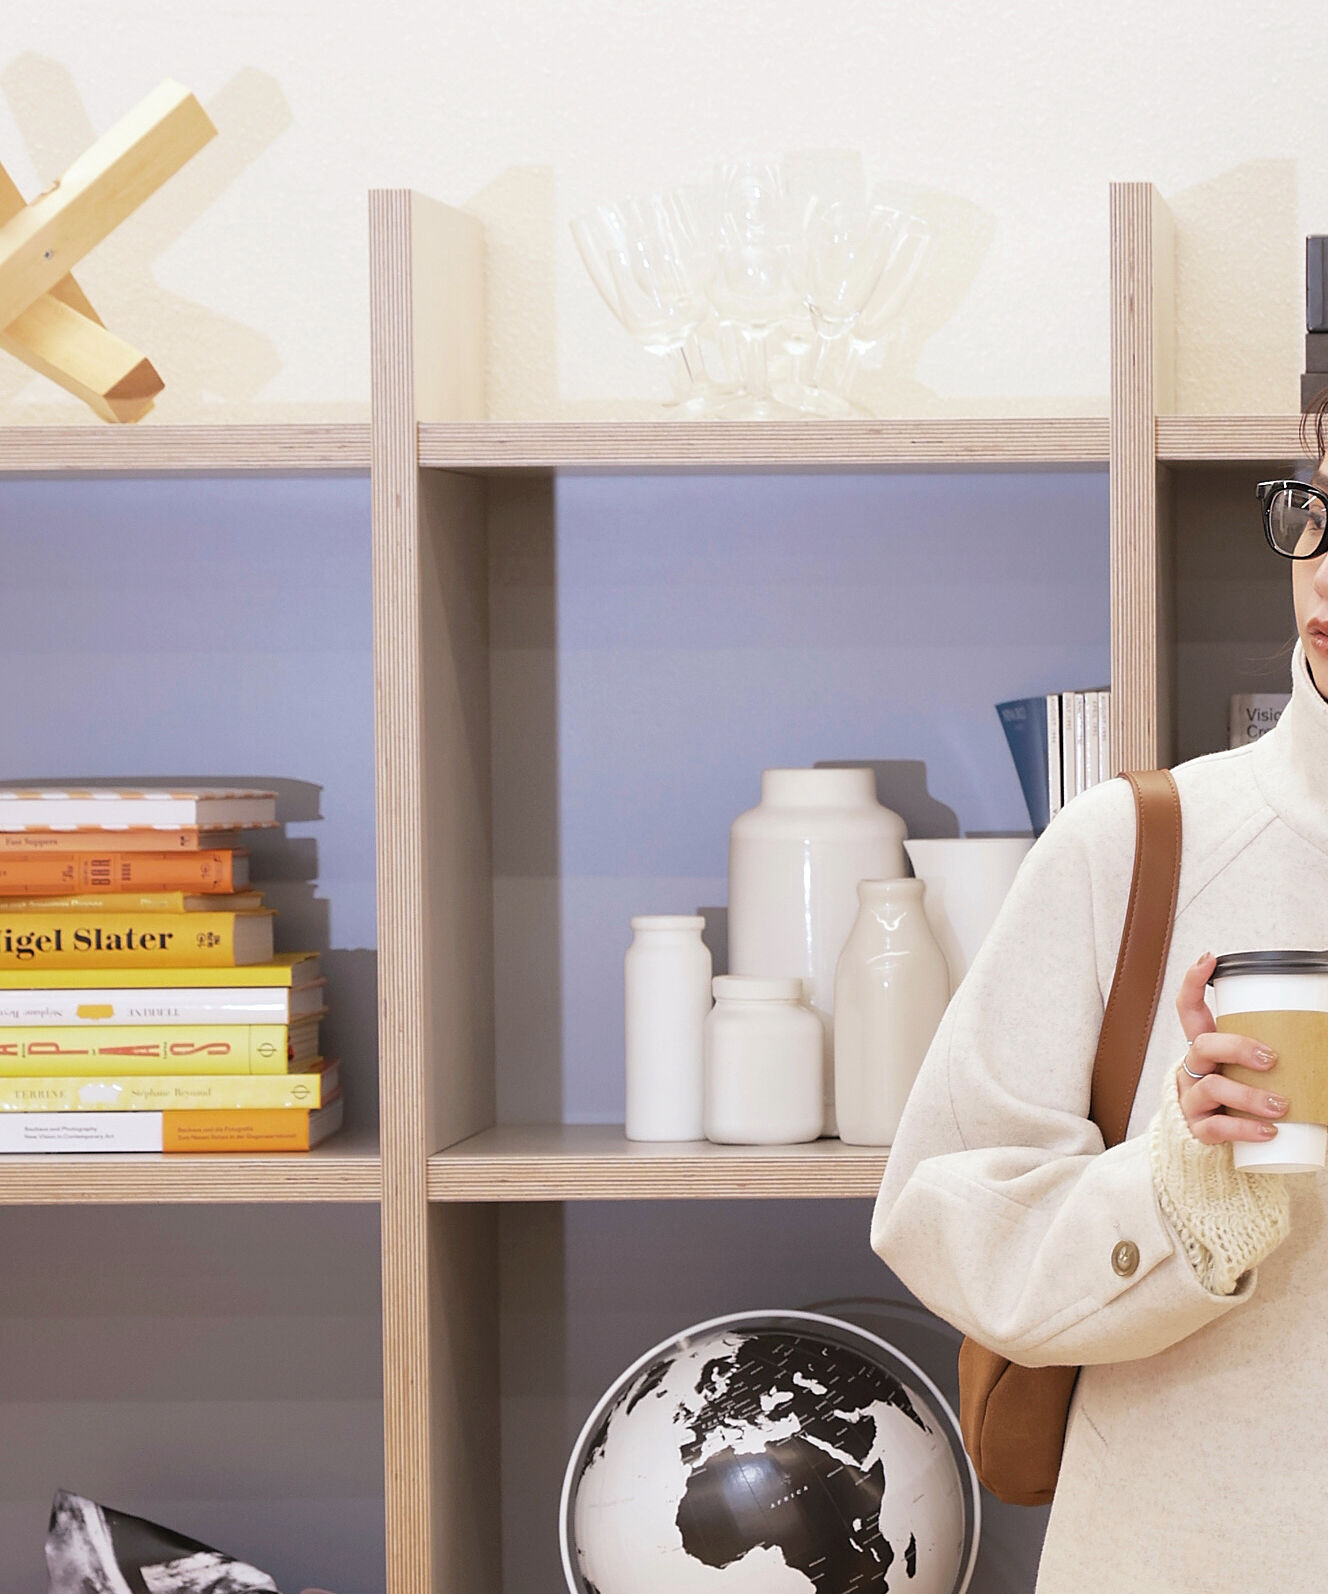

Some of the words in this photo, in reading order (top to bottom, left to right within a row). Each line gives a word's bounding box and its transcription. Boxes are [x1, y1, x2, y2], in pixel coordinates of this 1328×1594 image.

[0, 928, 63, 961] igel
[73, 928, 174, 952] Slater
[770, 1485, 809, 1509] AFRICA
